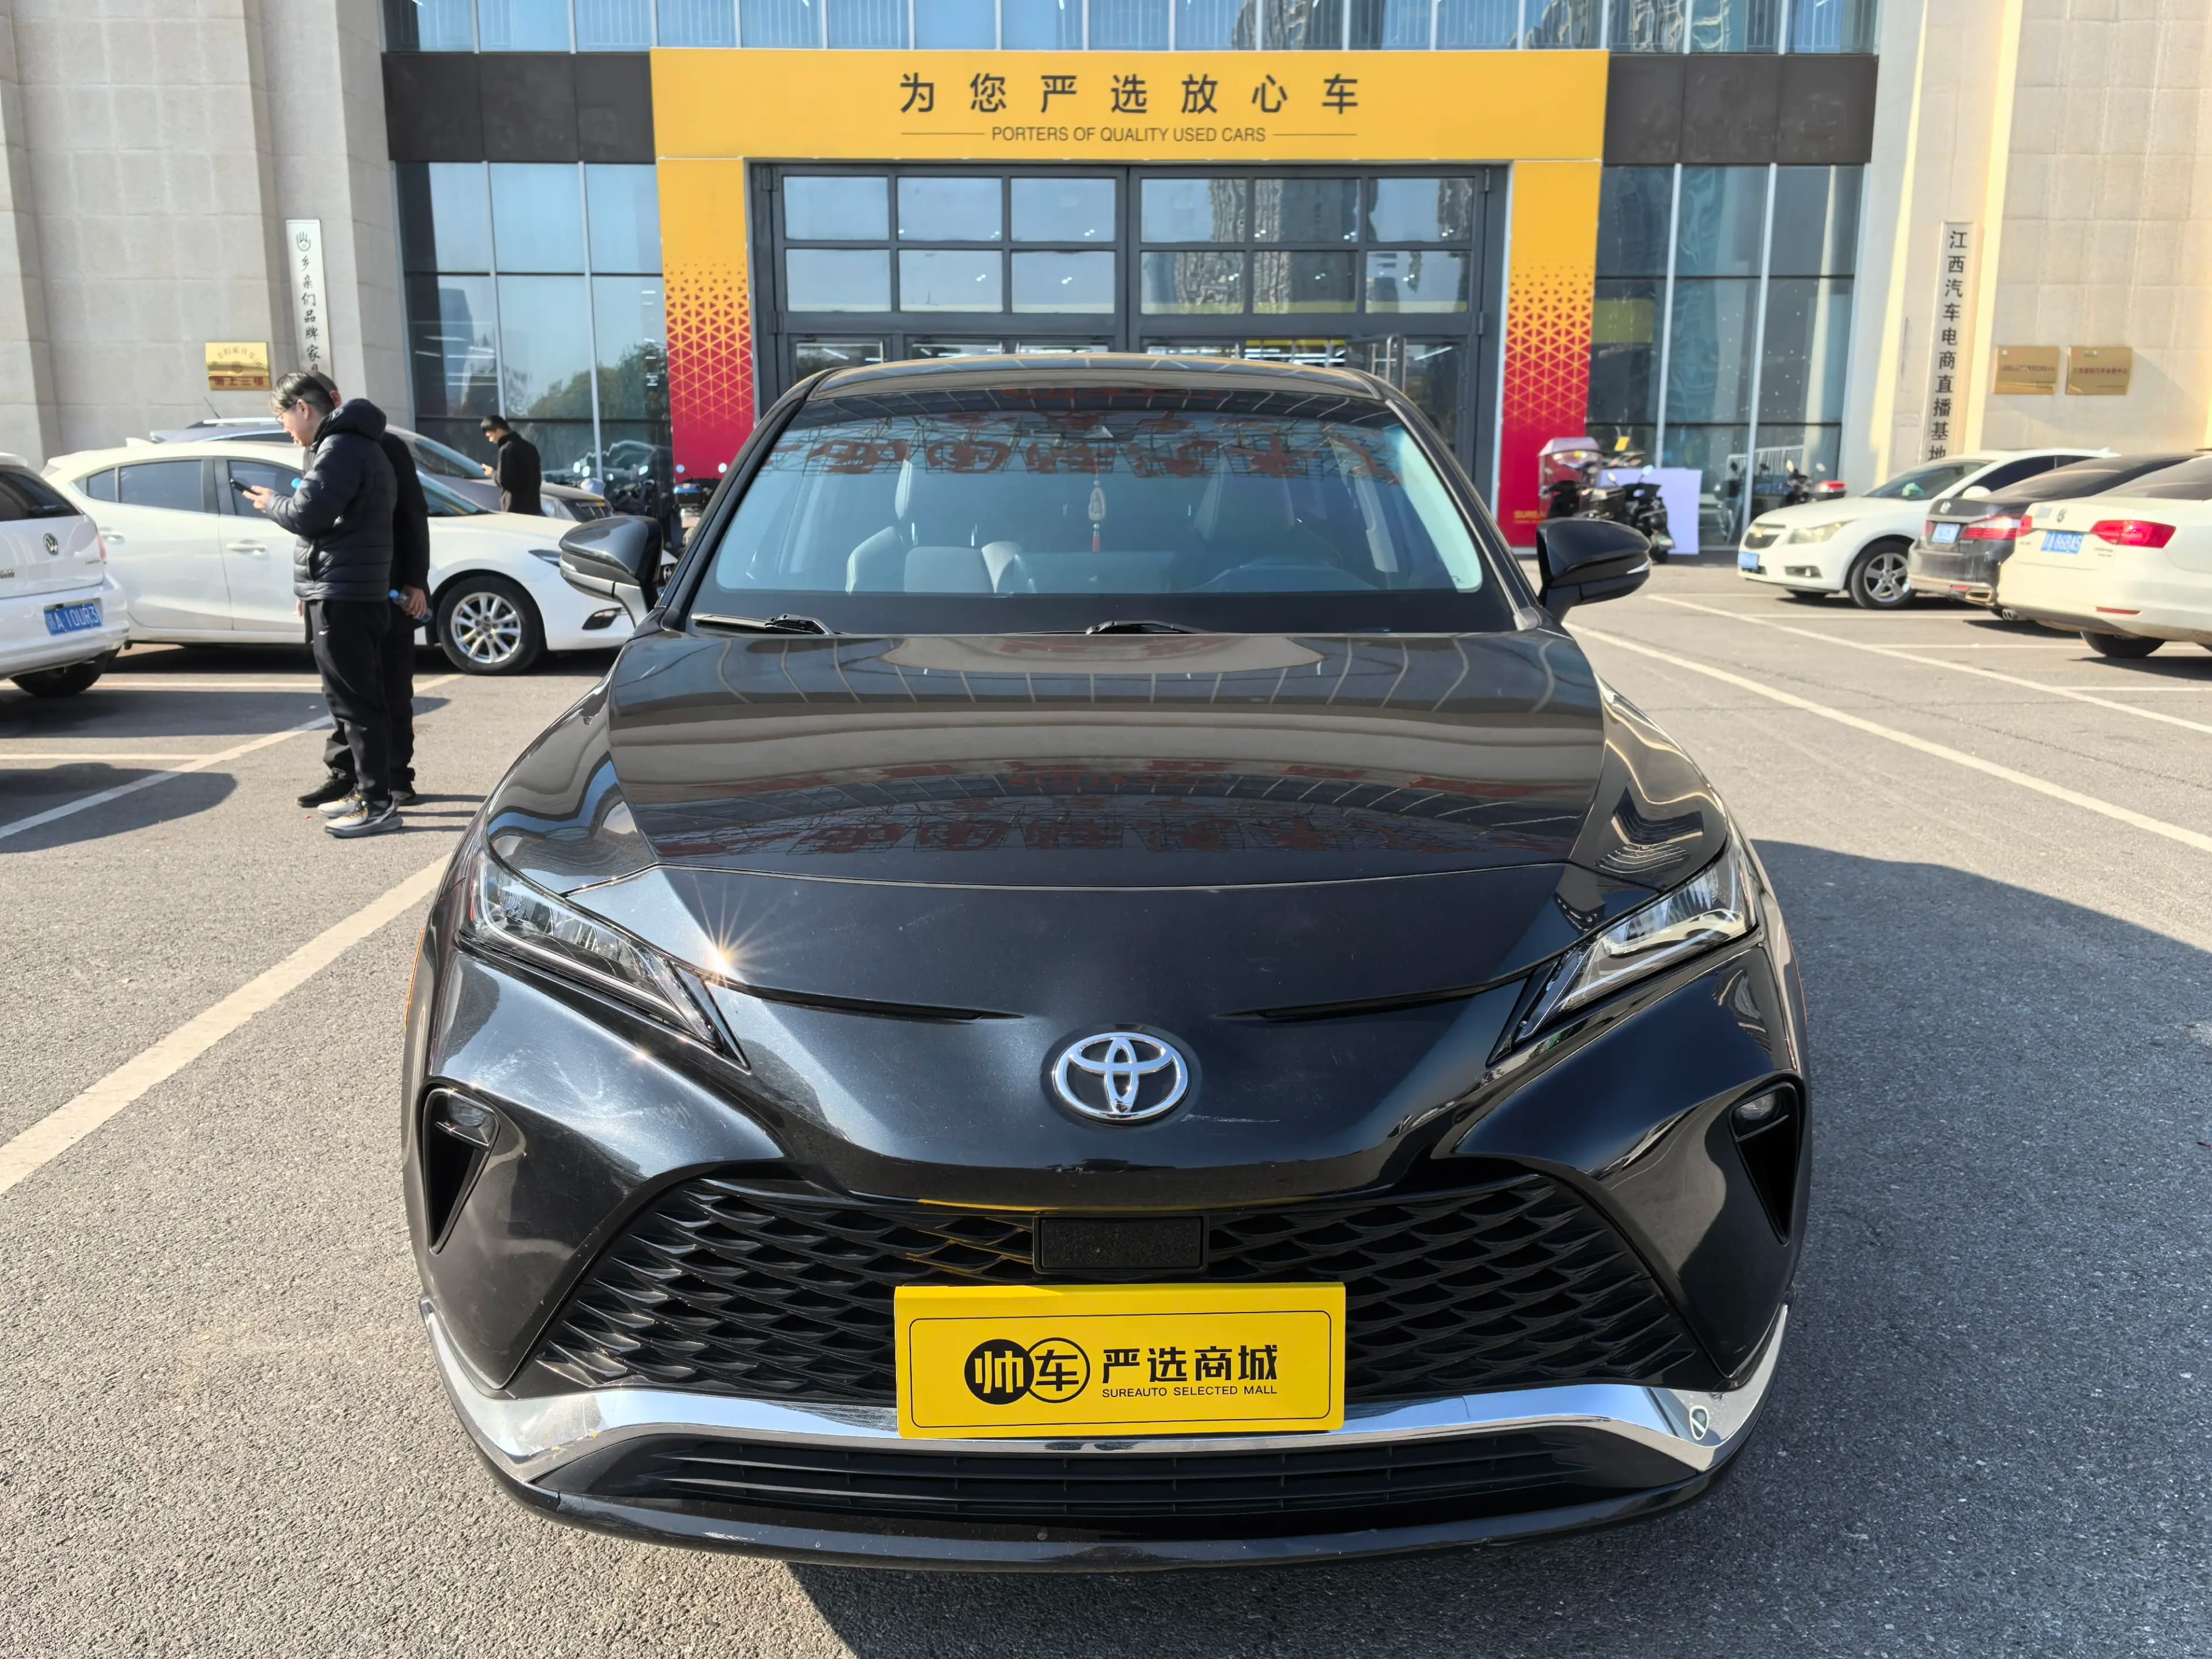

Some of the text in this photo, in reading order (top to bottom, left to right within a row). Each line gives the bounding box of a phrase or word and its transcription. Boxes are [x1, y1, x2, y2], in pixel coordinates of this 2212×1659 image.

[900, 73, 1358, 114] 为您严选放心车
[993, 126, 1265, 142] PORTERS OF QUALITY USED CARS
[1927, 230, 1967, 461] 江西汽车电商直播基地
[974, 1344, 1278, 1394] 帅车 严选商城
[1101, 1385, 1277, 1398] SUREAUTO SELECTED MALL
